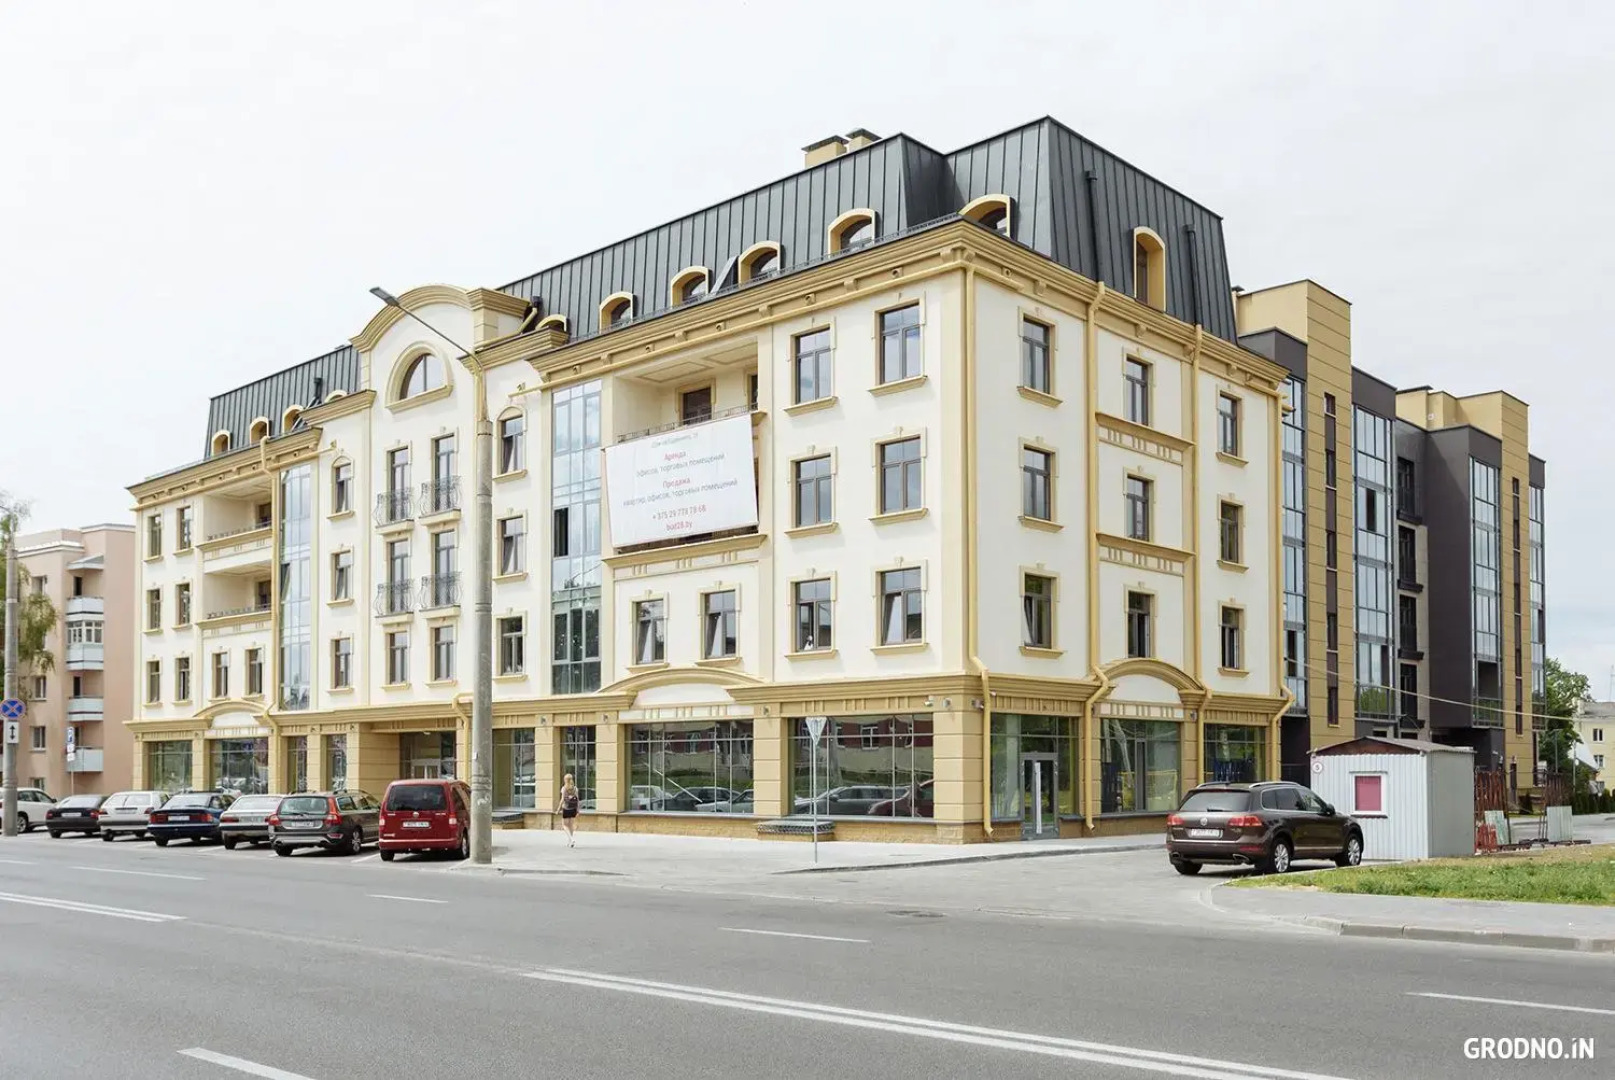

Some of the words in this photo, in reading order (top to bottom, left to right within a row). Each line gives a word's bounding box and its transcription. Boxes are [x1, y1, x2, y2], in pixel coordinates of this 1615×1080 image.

[664, 451, 686, 461] Аренда
[689, 453, 725, 467] помещений
[663, 478, 691, 489] Продажа
[672, 486, 700, 498] торговых
[701, 478, 738, 492] помещений
[657, 510, 668, 520] 375
[669, 508, 677, 518] 29
